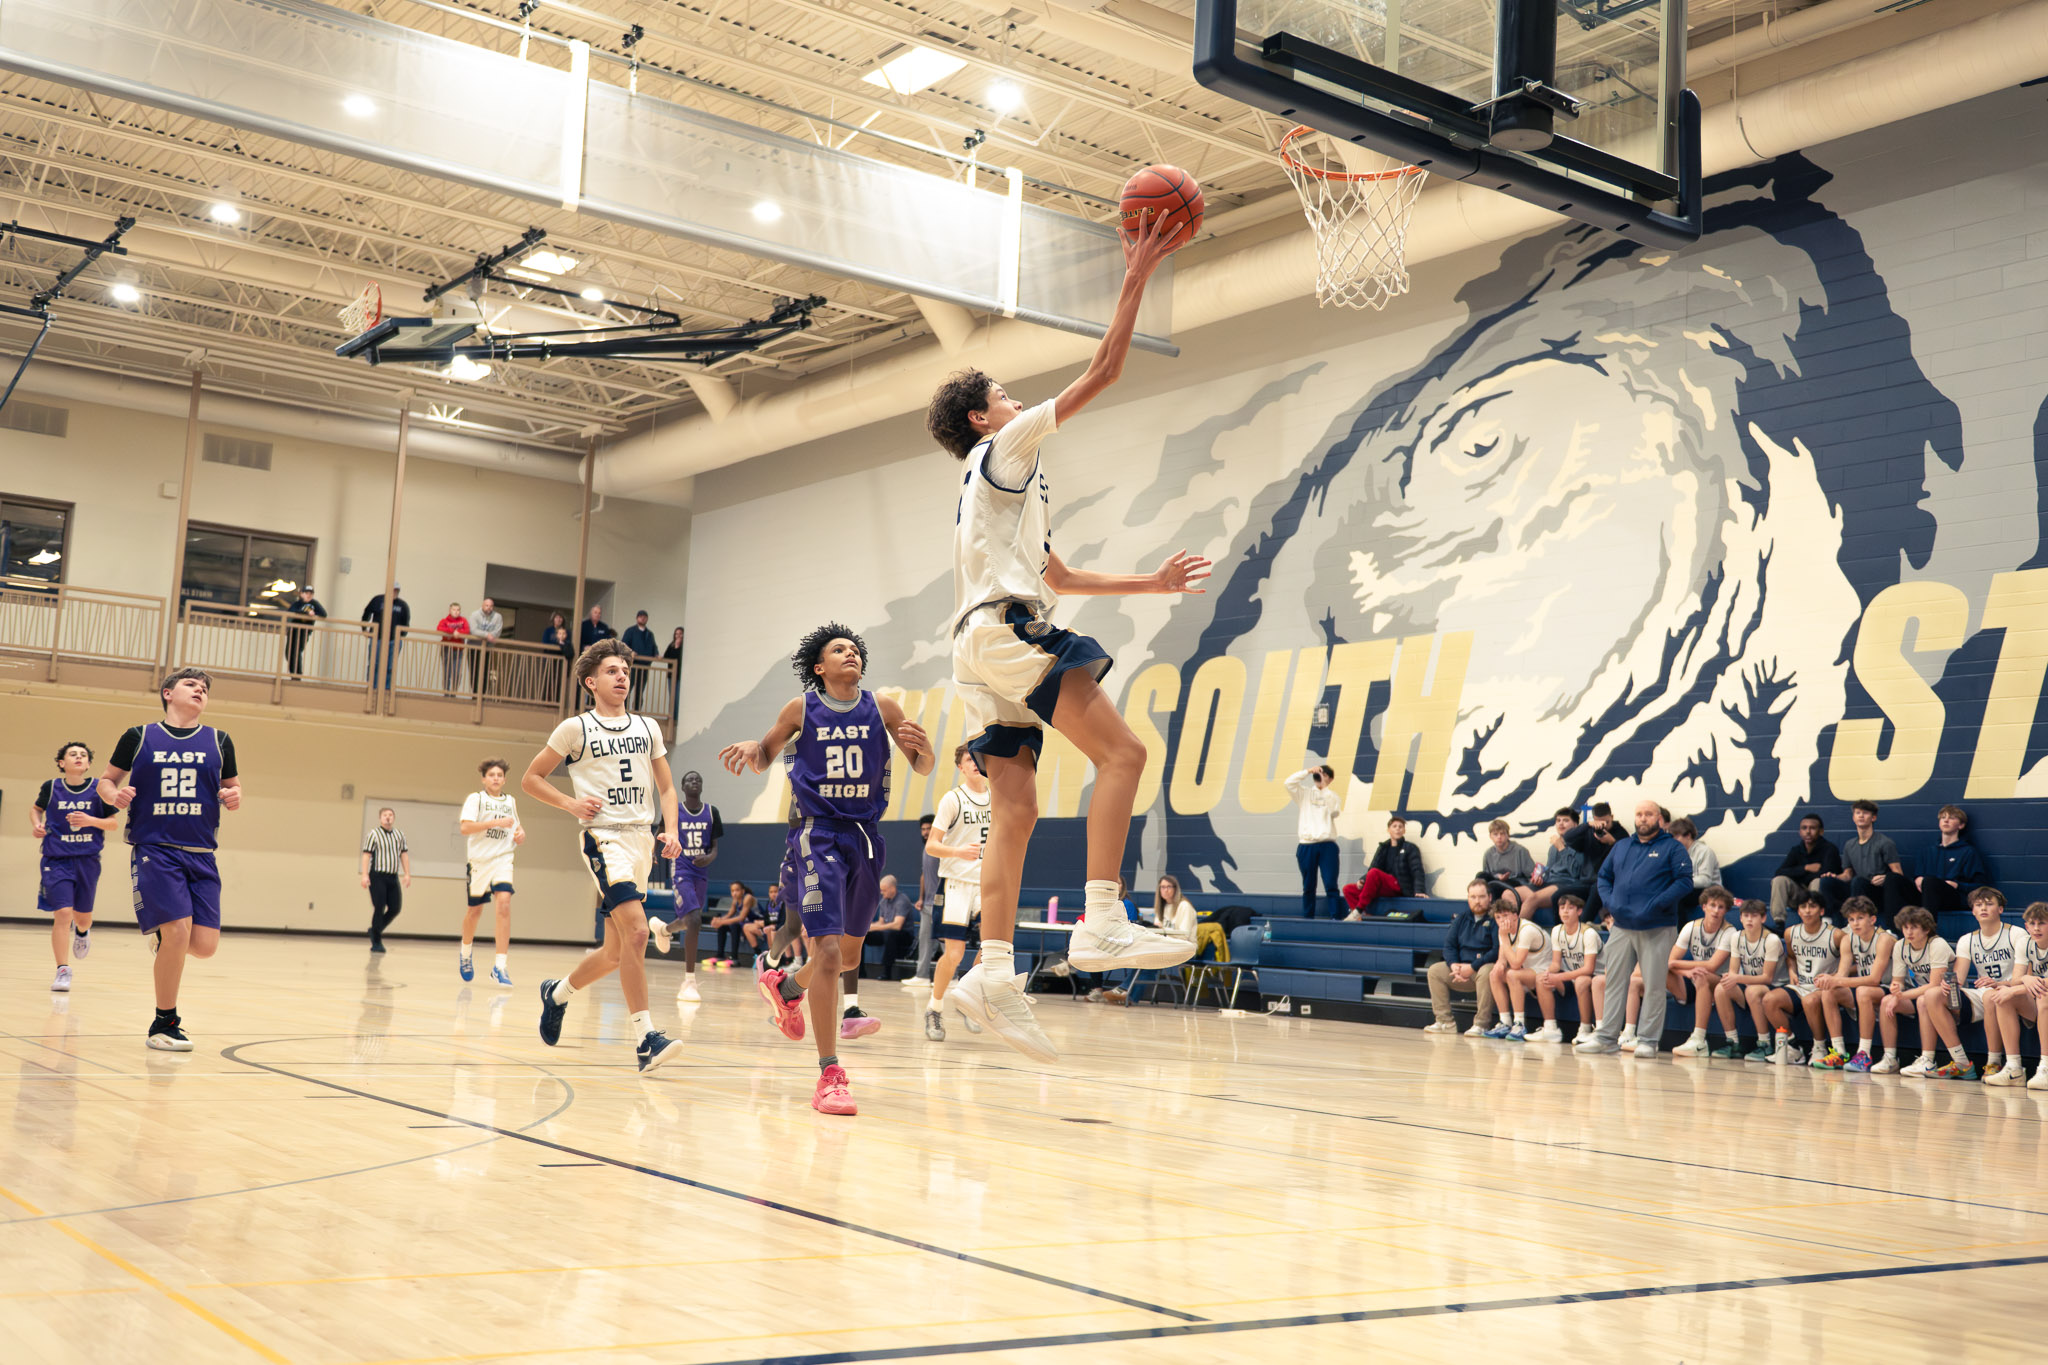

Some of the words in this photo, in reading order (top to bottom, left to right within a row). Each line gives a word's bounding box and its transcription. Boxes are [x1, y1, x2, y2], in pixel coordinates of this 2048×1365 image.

[1121, 630, 1475, 816] SOUTH
[815, 725, 870, 742] EAST
[589, 736, 649, 759] ELKHORN
[152, 750, 206, 764] EAST
[825, 744, 863, 779] 20
[619, 758, 633, 782] 2
[160, 767, 198, 798] 22
[818, 783, 870, 798] HIGH
[607, 786, 645, 806] SOUTH
[57, 800, 92, 810] EAST
[152, 802, 202, 816] HIGH
[681, 821, 708, 830] EAST
[963, 810, 992, 825] ELKHO
[60, 833, 93, 843] HIGH
[686, 831, 703, 848] 15
[1792, 944, 1828, 959] ELKHORN
[1974, 947, 2012, 965] ELKHORN
[1805, 959, 1813, 973] 3
